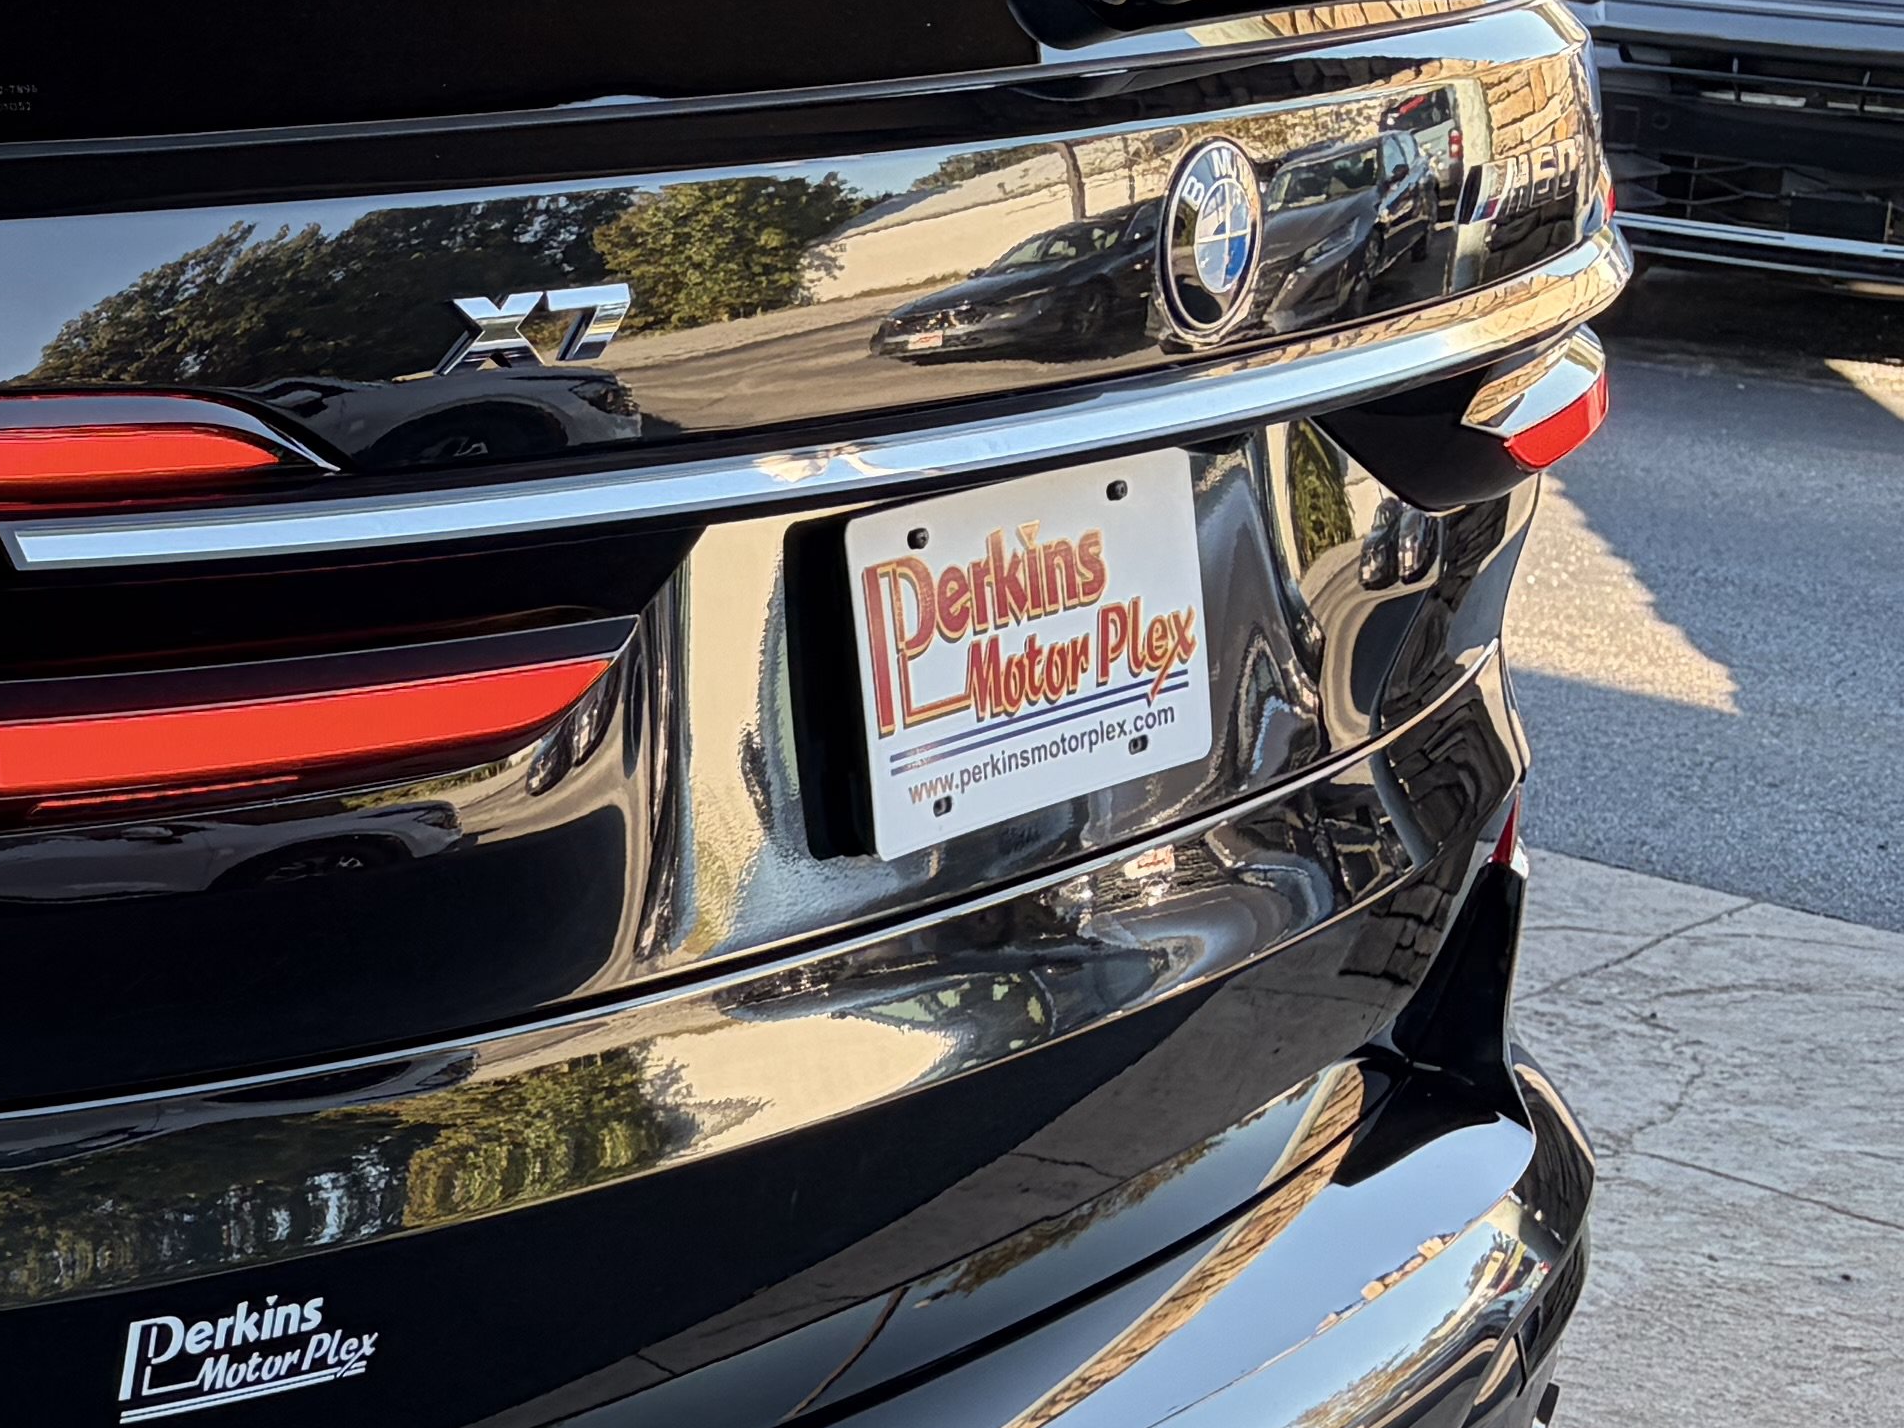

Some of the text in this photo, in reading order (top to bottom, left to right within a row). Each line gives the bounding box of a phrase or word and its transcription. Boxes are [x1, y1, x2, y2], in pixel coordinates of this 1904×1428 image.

[434, 282, 632, 376] X7
[861, 518, 1108, 740] Perkins
[965, 596, 1198, 724] Motor Plex
[907, 704, 1177, 805] www.perkinsmotorplex.com
[118, 1294, 325, 1401] Perkins
[195, 1328, 379, 1392] Motor Plex
